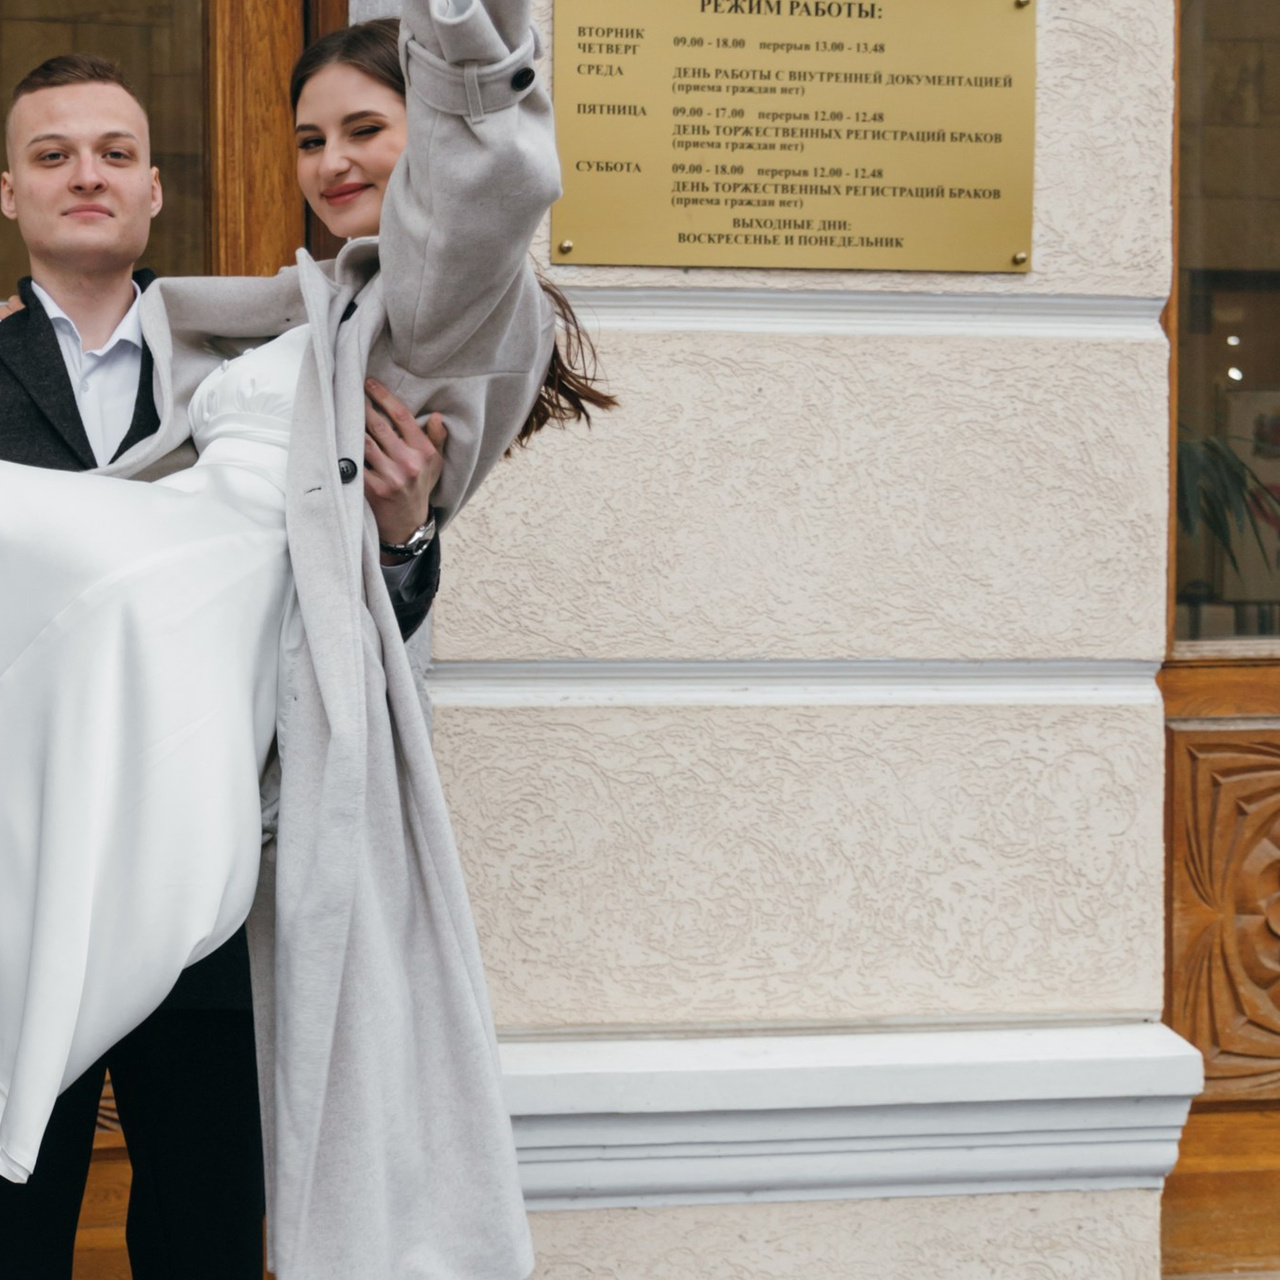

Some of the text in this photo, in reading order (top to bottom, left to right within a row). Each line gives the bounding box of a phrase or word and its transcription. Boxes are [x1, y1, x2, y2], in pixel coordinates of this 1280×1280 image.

[789, 0, 883, 19] РАБОТЫ:
[577, 26, 645, 39] ВТОРНИК
[577, 42, 640, 55] ЧЕТВЕРГ
[673, 36, 704, 48] 09.00
[715, 37, 746, 49] 18.00
[759, 41, 811, 54] перерыв
[815, 41, 845, 53] 13.00
[577, 63, 624, 76] СРЕДА
[672, 67, 1013, 88] ДЕНЬ РАБОТЫ С ВНУТРЕННЕЙ ДОКУМЕНТАЦИЕЙ
[726, 85, 776, 95] граждан
[780, 85, 806, 96] нет)
[576, 103, 647, 116] ПЯТНИЦА
[673, 107, 703, 118] 09.00
[715, 108, 745, 119] 17.00
[758, 111, 810, 123] перерыв
[814, 111, 844, 122] 12.00
[855, 112, 885, 124] 12.48
[672, 124, 1003, 143] ДЕНЬ ТОРЖЕСТВЕННЫХ РЕГИСТРАЦИЙ БРАКОВ
[725, 141, 776, 152] граждан
[780, 141, 805, 152] нет)
[575, 161, 642, 173] СУББОТА
[672, 164, 703, 175] 09.00
[714, 164, 745, 176] 18.00
[757, 168, 809, 180] перерыв
[814, 167, 843, 178] 12.00
[854, 168, 884, 179] 12.48
[672, 181, 1002, 199] ДЕНЬ ТОРЖЕСТВЕННЫХ РЕГИСТРАЦИЙ БРАКОВ
[725, 198, 775, 208] граждан
[779, 198, 804, 209] нет)
[733, 218, 852, 232] ВЫХОДНЫЕ ДНИ:
[678, 233, 904, 249] ВОСКРЕСЕНЬЕ И ПОНЕДЕЛЬНИК
